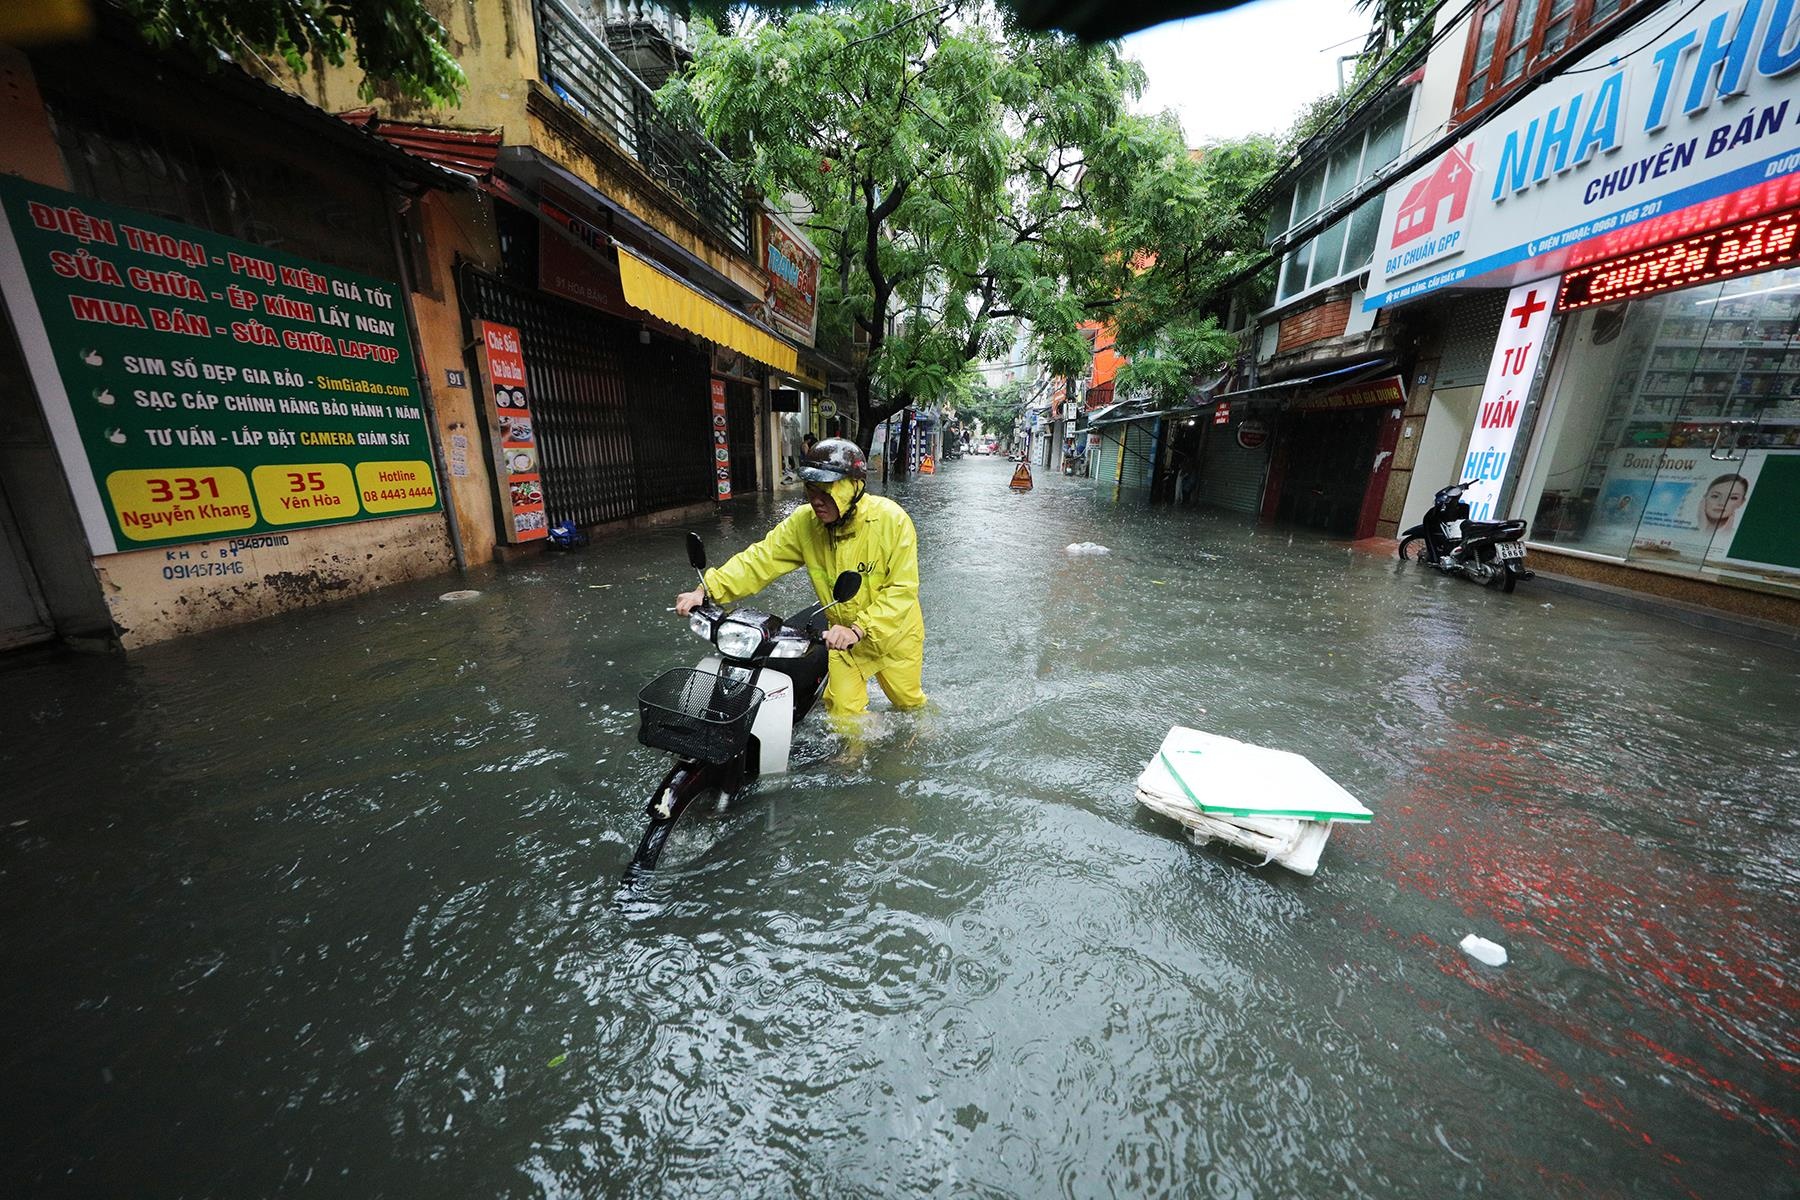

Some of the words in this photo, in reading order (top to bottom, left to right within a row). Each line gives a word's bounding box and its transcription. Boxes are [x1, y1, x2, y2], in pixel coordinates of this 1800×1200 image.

[1491, 55, 1625, 201] NHÀ
[1584, 136, 1698, 205] CHUYÊN
[1704, 99, 1790, 160] BÁN
[1538, 235, 1560, 252] ĐIỆN
[1640, 200, 1662, 218] 201
[27, 200, 118, 246] ĐIỆN
[119, 224, 208, 268] THOẠI
[227, 252, 276, 286] PHỤ
[279, 265, 328, 295] KIỆN
[332, 280, 362, 302] GIÁ
[364, 286, 392, 309] TỐT
[1385, 255, 1401, 273] ĐẠT
[1438, 230, 1461, 252] GPP
[1589, 243, 1709, 295] CHUYÊN
[1717, 223, 1797, 265] BÁN
[49, 248, 125, 287] SỬA
[127, 267, 208, 303] CHỮA
[226, 284, 258, 311] ÉP
[262, 293, 315, 323] KÍNH
[318, 305, 350, 329] LẤY
[355, 314, 395, 337] NGAY
[68, 294, 148, 329] MUA
[149, 307, 212, 338] BÁN
[231, 318, 280, 348] SỬA
[282, 331, 337, 356] CHỮA
[339, 338, 399, 364] LAPTOP
[123, 356, 167, 376] SIM
[171, 357, 198, 378] SỐ
[202, 363, 237, 384] ĐẸP
[242, 368, 271, 385] GIA
[273, 367, 304, 388] BẢO
[316, 375, 409, 397] SimGiaBao.com
[1501, 342, 1532, 377] TƯ
[448, 372, 462, 385] 91
[133, 390, 177, 411] SẠC
[181, 390, 219, 410] CÁP
[224, 394, 276, 413] CHÍNH
[278, 396, 319, 415] HÃNG
[322, 398, 349, 416] BẢO
[351, 403, 384, 418] HÀNH
[386, 406, 393, 418] 1
[396, 405, 420, 420] NĂM
[1481, 390, 1519, 429] VẤN
[144, 428, 172, 446] TƯ
[175, 424, 217, 446] VẤN
[231, 425, 263, 446] LẮP
[267, 429, 296, 449] ĐẶT
[300, 432, 356, 446] CAMERA
[357, 430, 388, 446] GIÁM
[391, 431, 410, 446] SÁT
[379, 470, 416, 483] Hotline
[1464, 446, 1506, 485] HIỆU
[1623, 453, 1655, 469] Boni
[1656, 454, 1697, 470] Snow
[146, 477, 220, 503] 331
[287, 472, 325, 493] 35
[363, 490, 378, 503] 08
[381, 488, 406, 500] 4443
[408, 486, 433, 498] 4444
[121, 504, 195, 529] Nguyễn
[198, 503, 251, 519] Khang
[280, 495, 310, 510] Yên
[314, 494, 341, 507] Hòa
